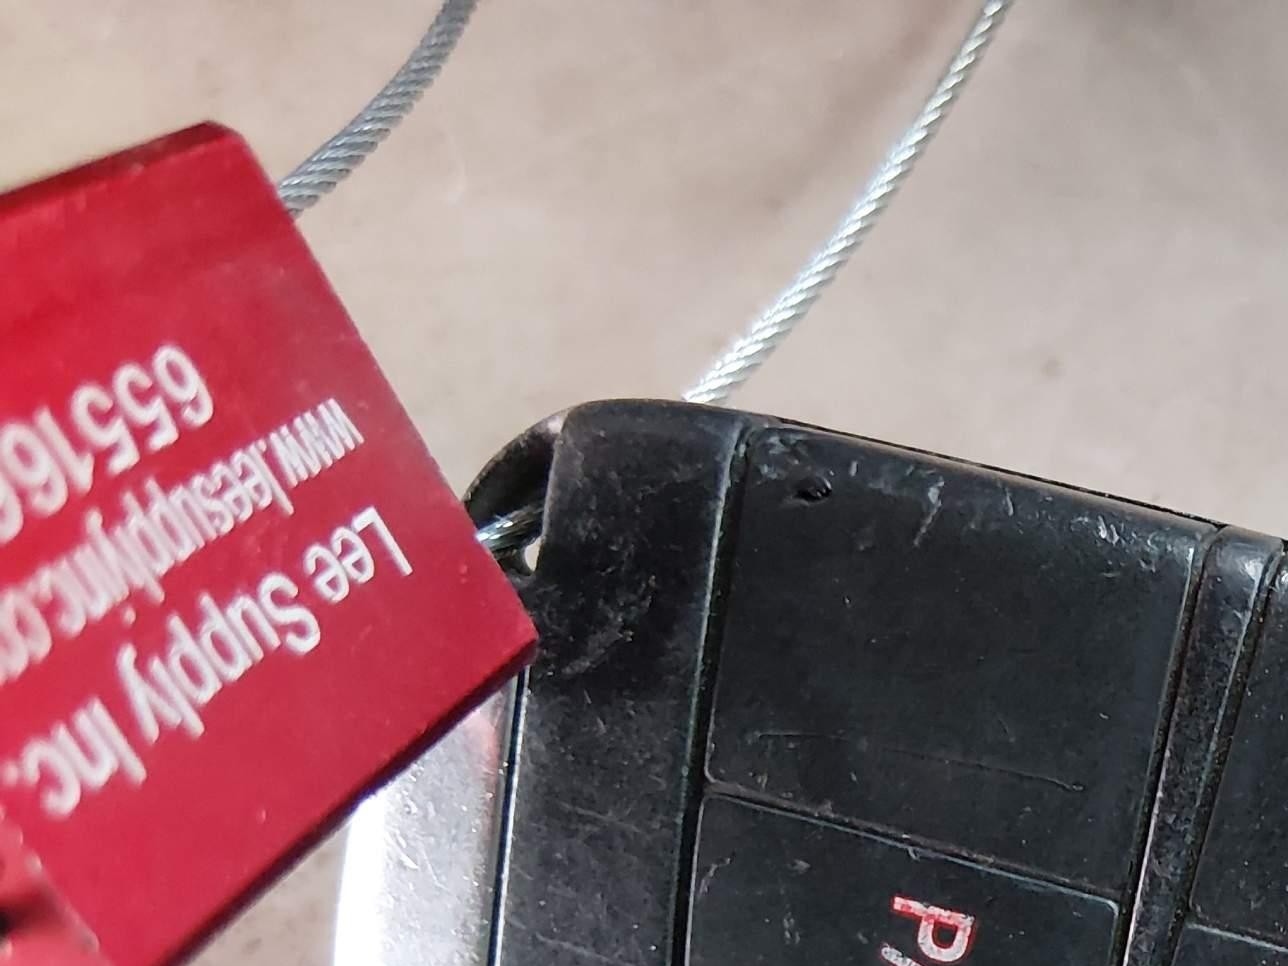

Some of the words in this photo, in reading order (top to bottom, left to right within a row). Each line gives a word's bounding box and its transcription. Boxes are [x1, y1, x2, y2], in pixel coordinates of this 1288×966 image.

[0, 397, 365, 690] www.leesupplyinc.co
[304, 505, 413, 603] Lee
[116, 571, 321, 744] Supply
[2, 697, 147, 819] Inc.
